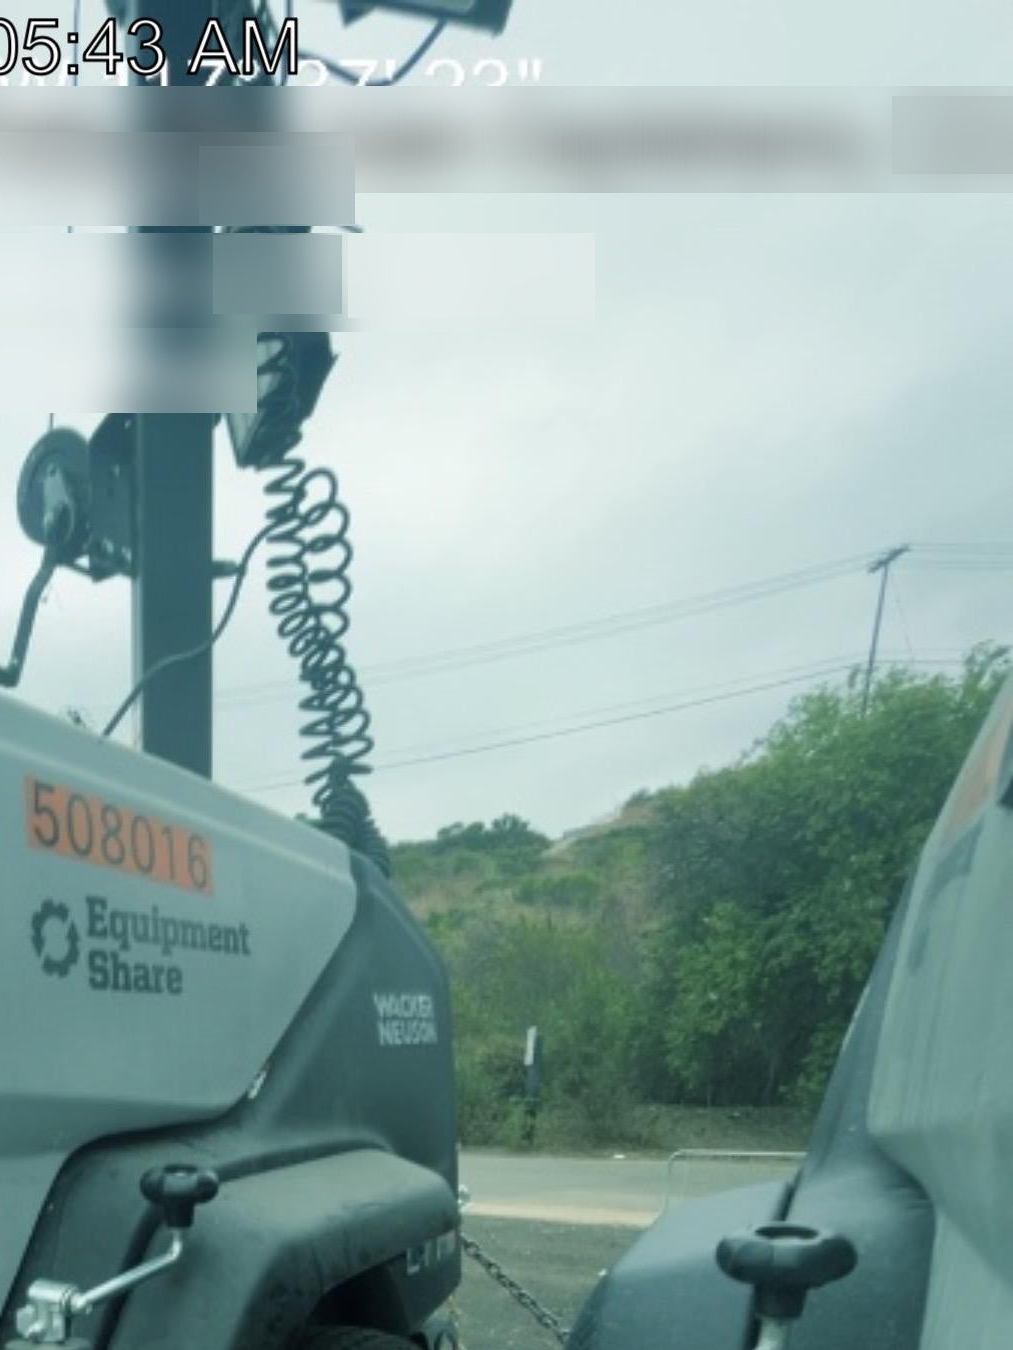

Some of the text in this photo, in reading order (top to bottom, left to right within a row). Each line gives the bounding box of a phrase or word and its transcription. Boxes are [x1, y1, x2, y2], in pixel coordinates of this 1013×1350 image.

[33, 779, 208, 889] 508016
[85, 895, 252, 956] Equipment
[87, 947, 184, 995] Share
[374, 992, 435, 1019] WACKER
[379, 1018, 439, 1047] NEUSON
